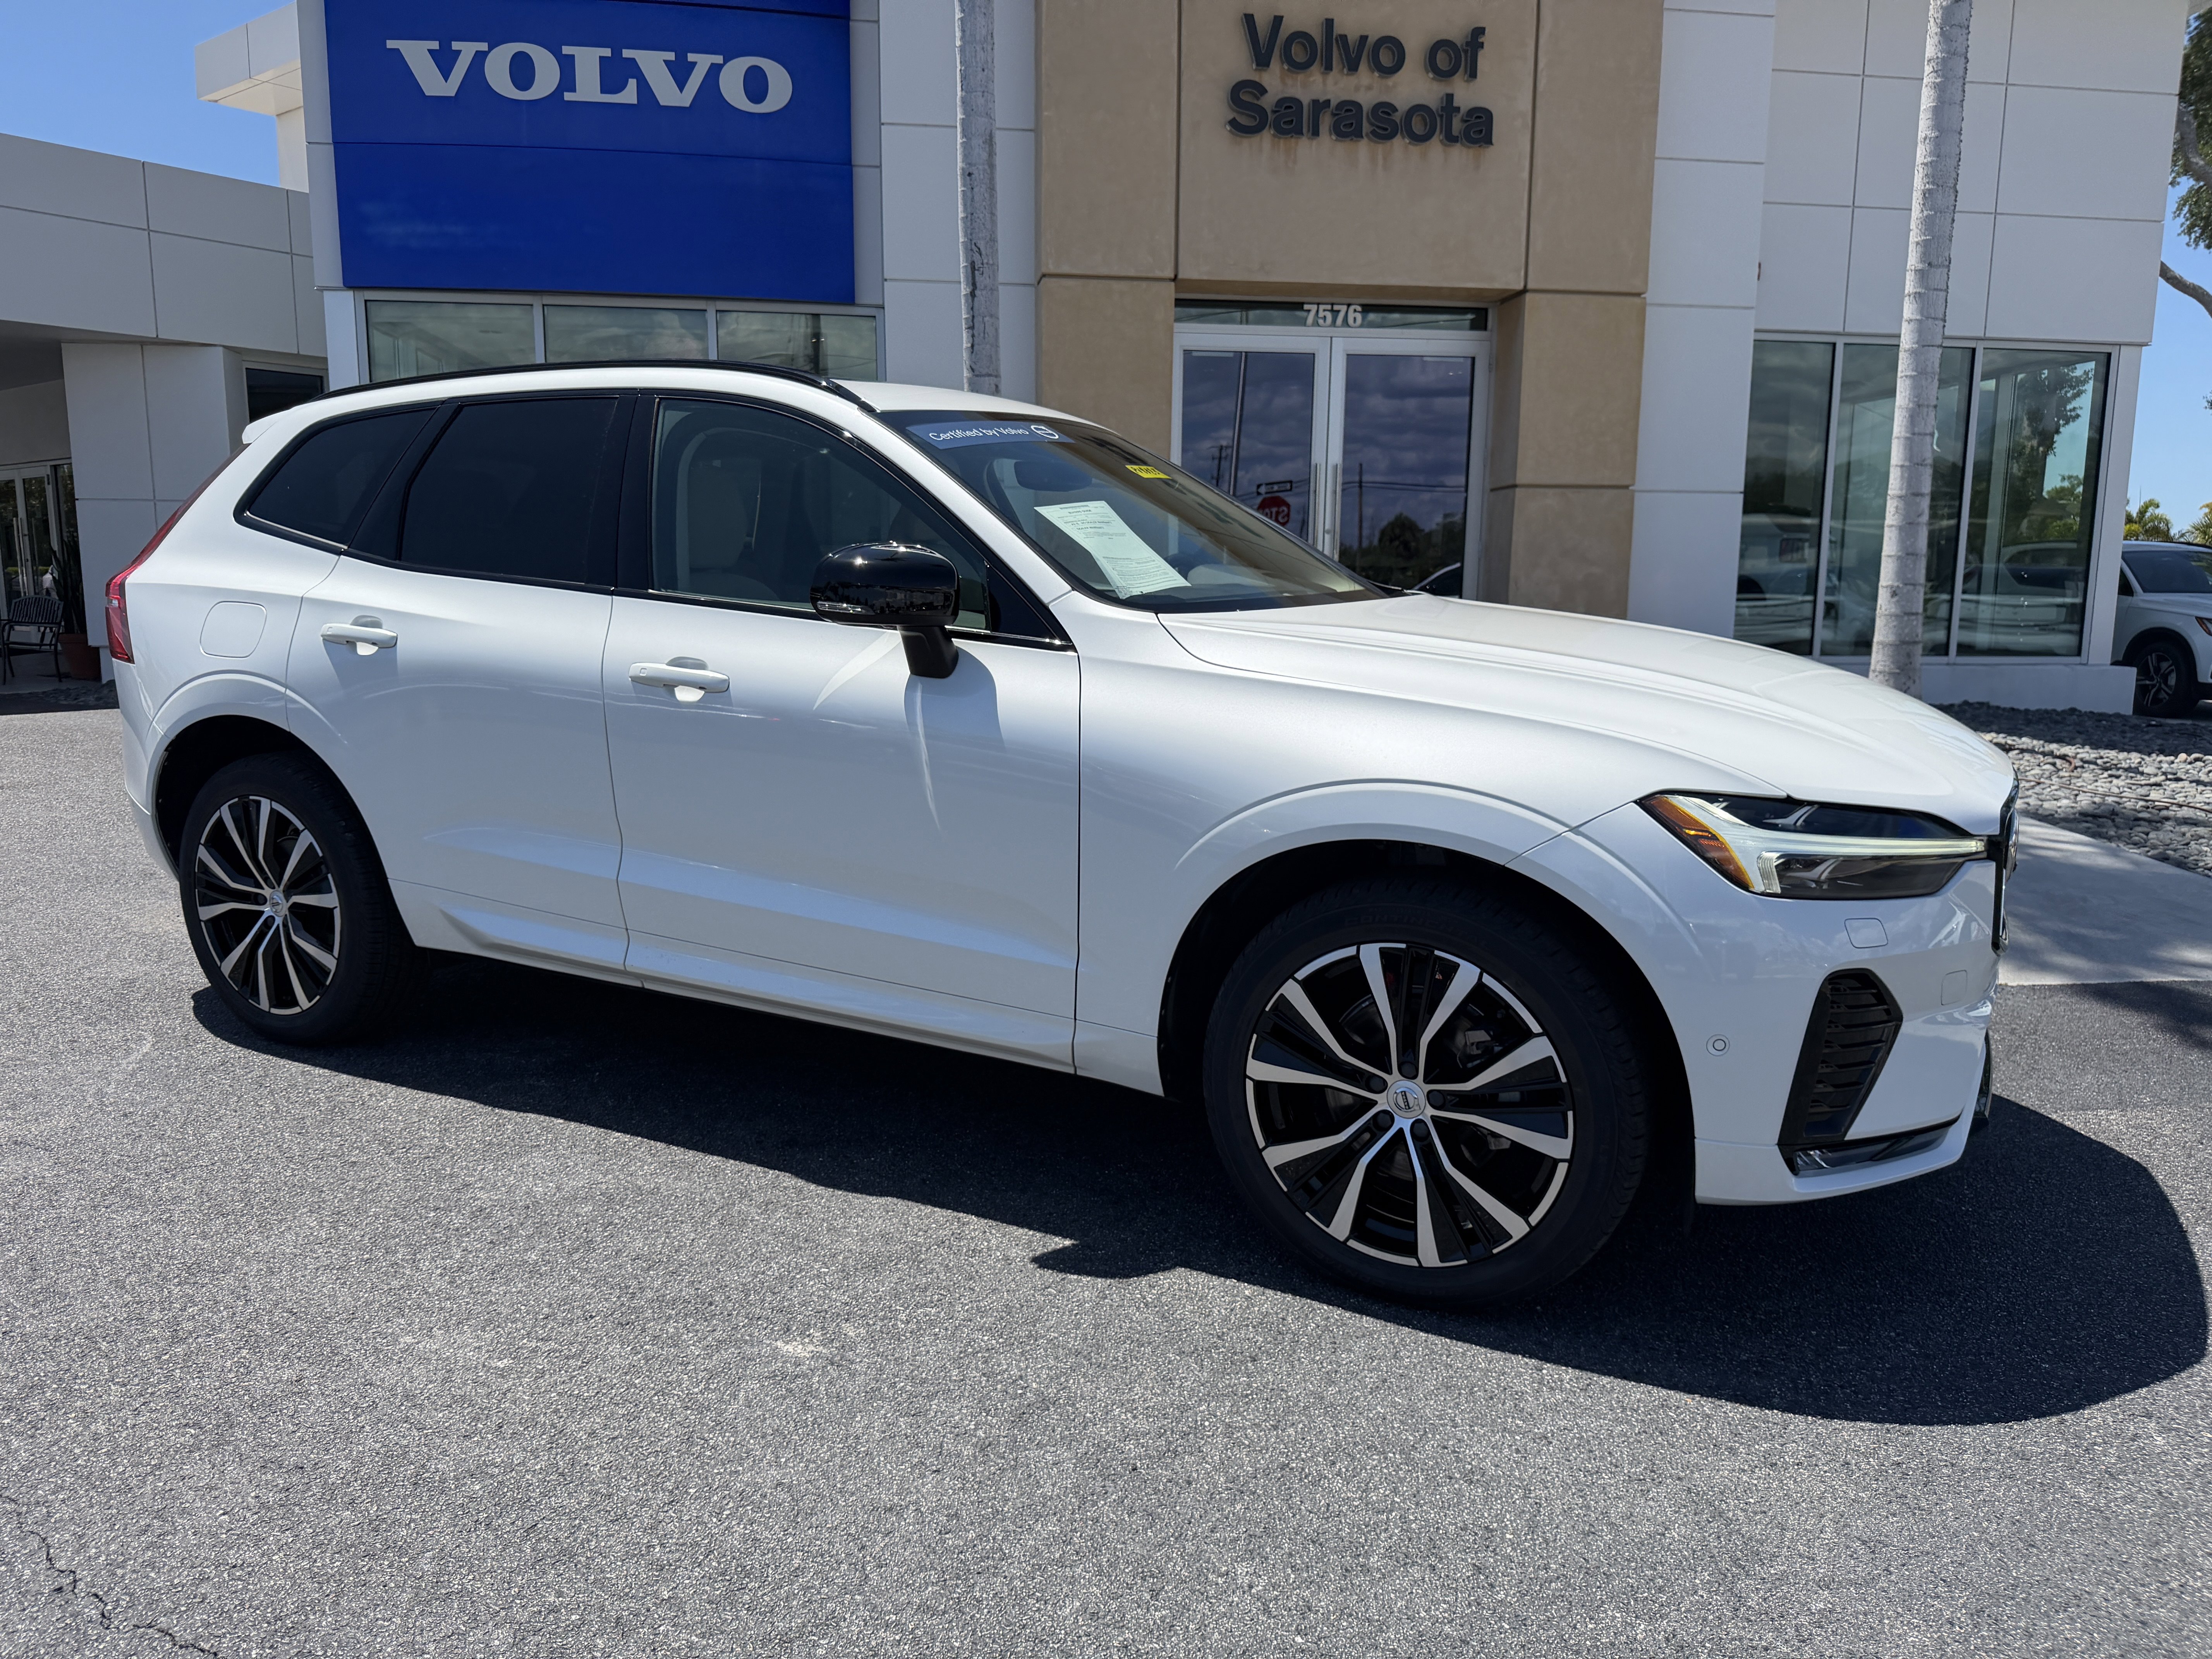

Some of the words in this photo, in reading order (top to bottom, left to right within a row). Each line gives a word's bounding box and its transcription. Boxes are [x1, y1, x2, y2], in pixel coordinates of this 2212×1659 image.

[386, 40, 792, 113] VOLVO
[1241, 13, 1406, 76] Volvo
[1425, 26, 1486, 81] of
[1225, 79, 1494, 147] Sarasota
[1303, 303, 1363, 328] 7576
[929, 429, 983, 440] Certified
[979, 428, 1000, 436] by
